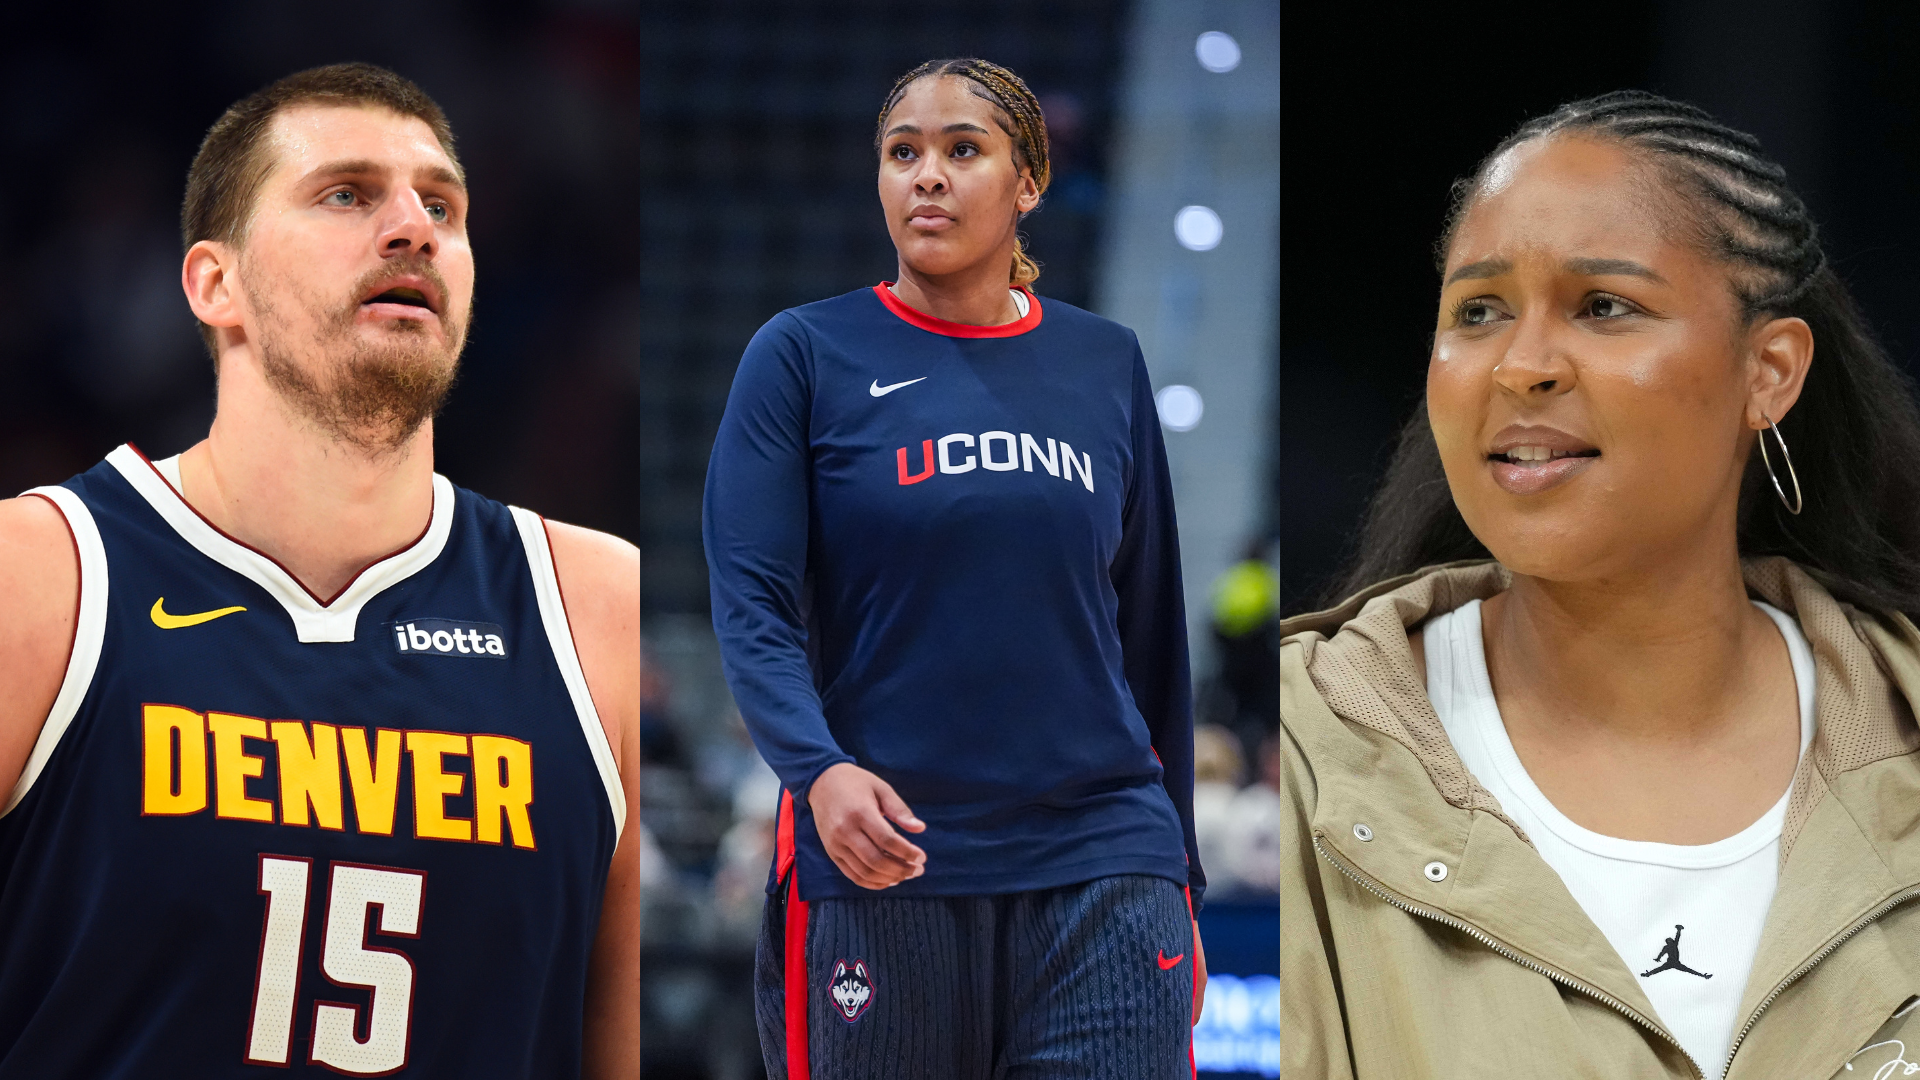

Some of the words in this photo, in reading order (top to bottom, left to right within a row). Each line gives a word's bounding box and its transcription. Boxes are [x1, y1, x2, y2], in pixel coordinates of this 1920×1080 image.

[897, 431, 1095, 493] UCONN
[395, 623, 505, 656] ibotta
[141, 703, 537, 850] DENVER
[244, 854, 427, 1076] 15
